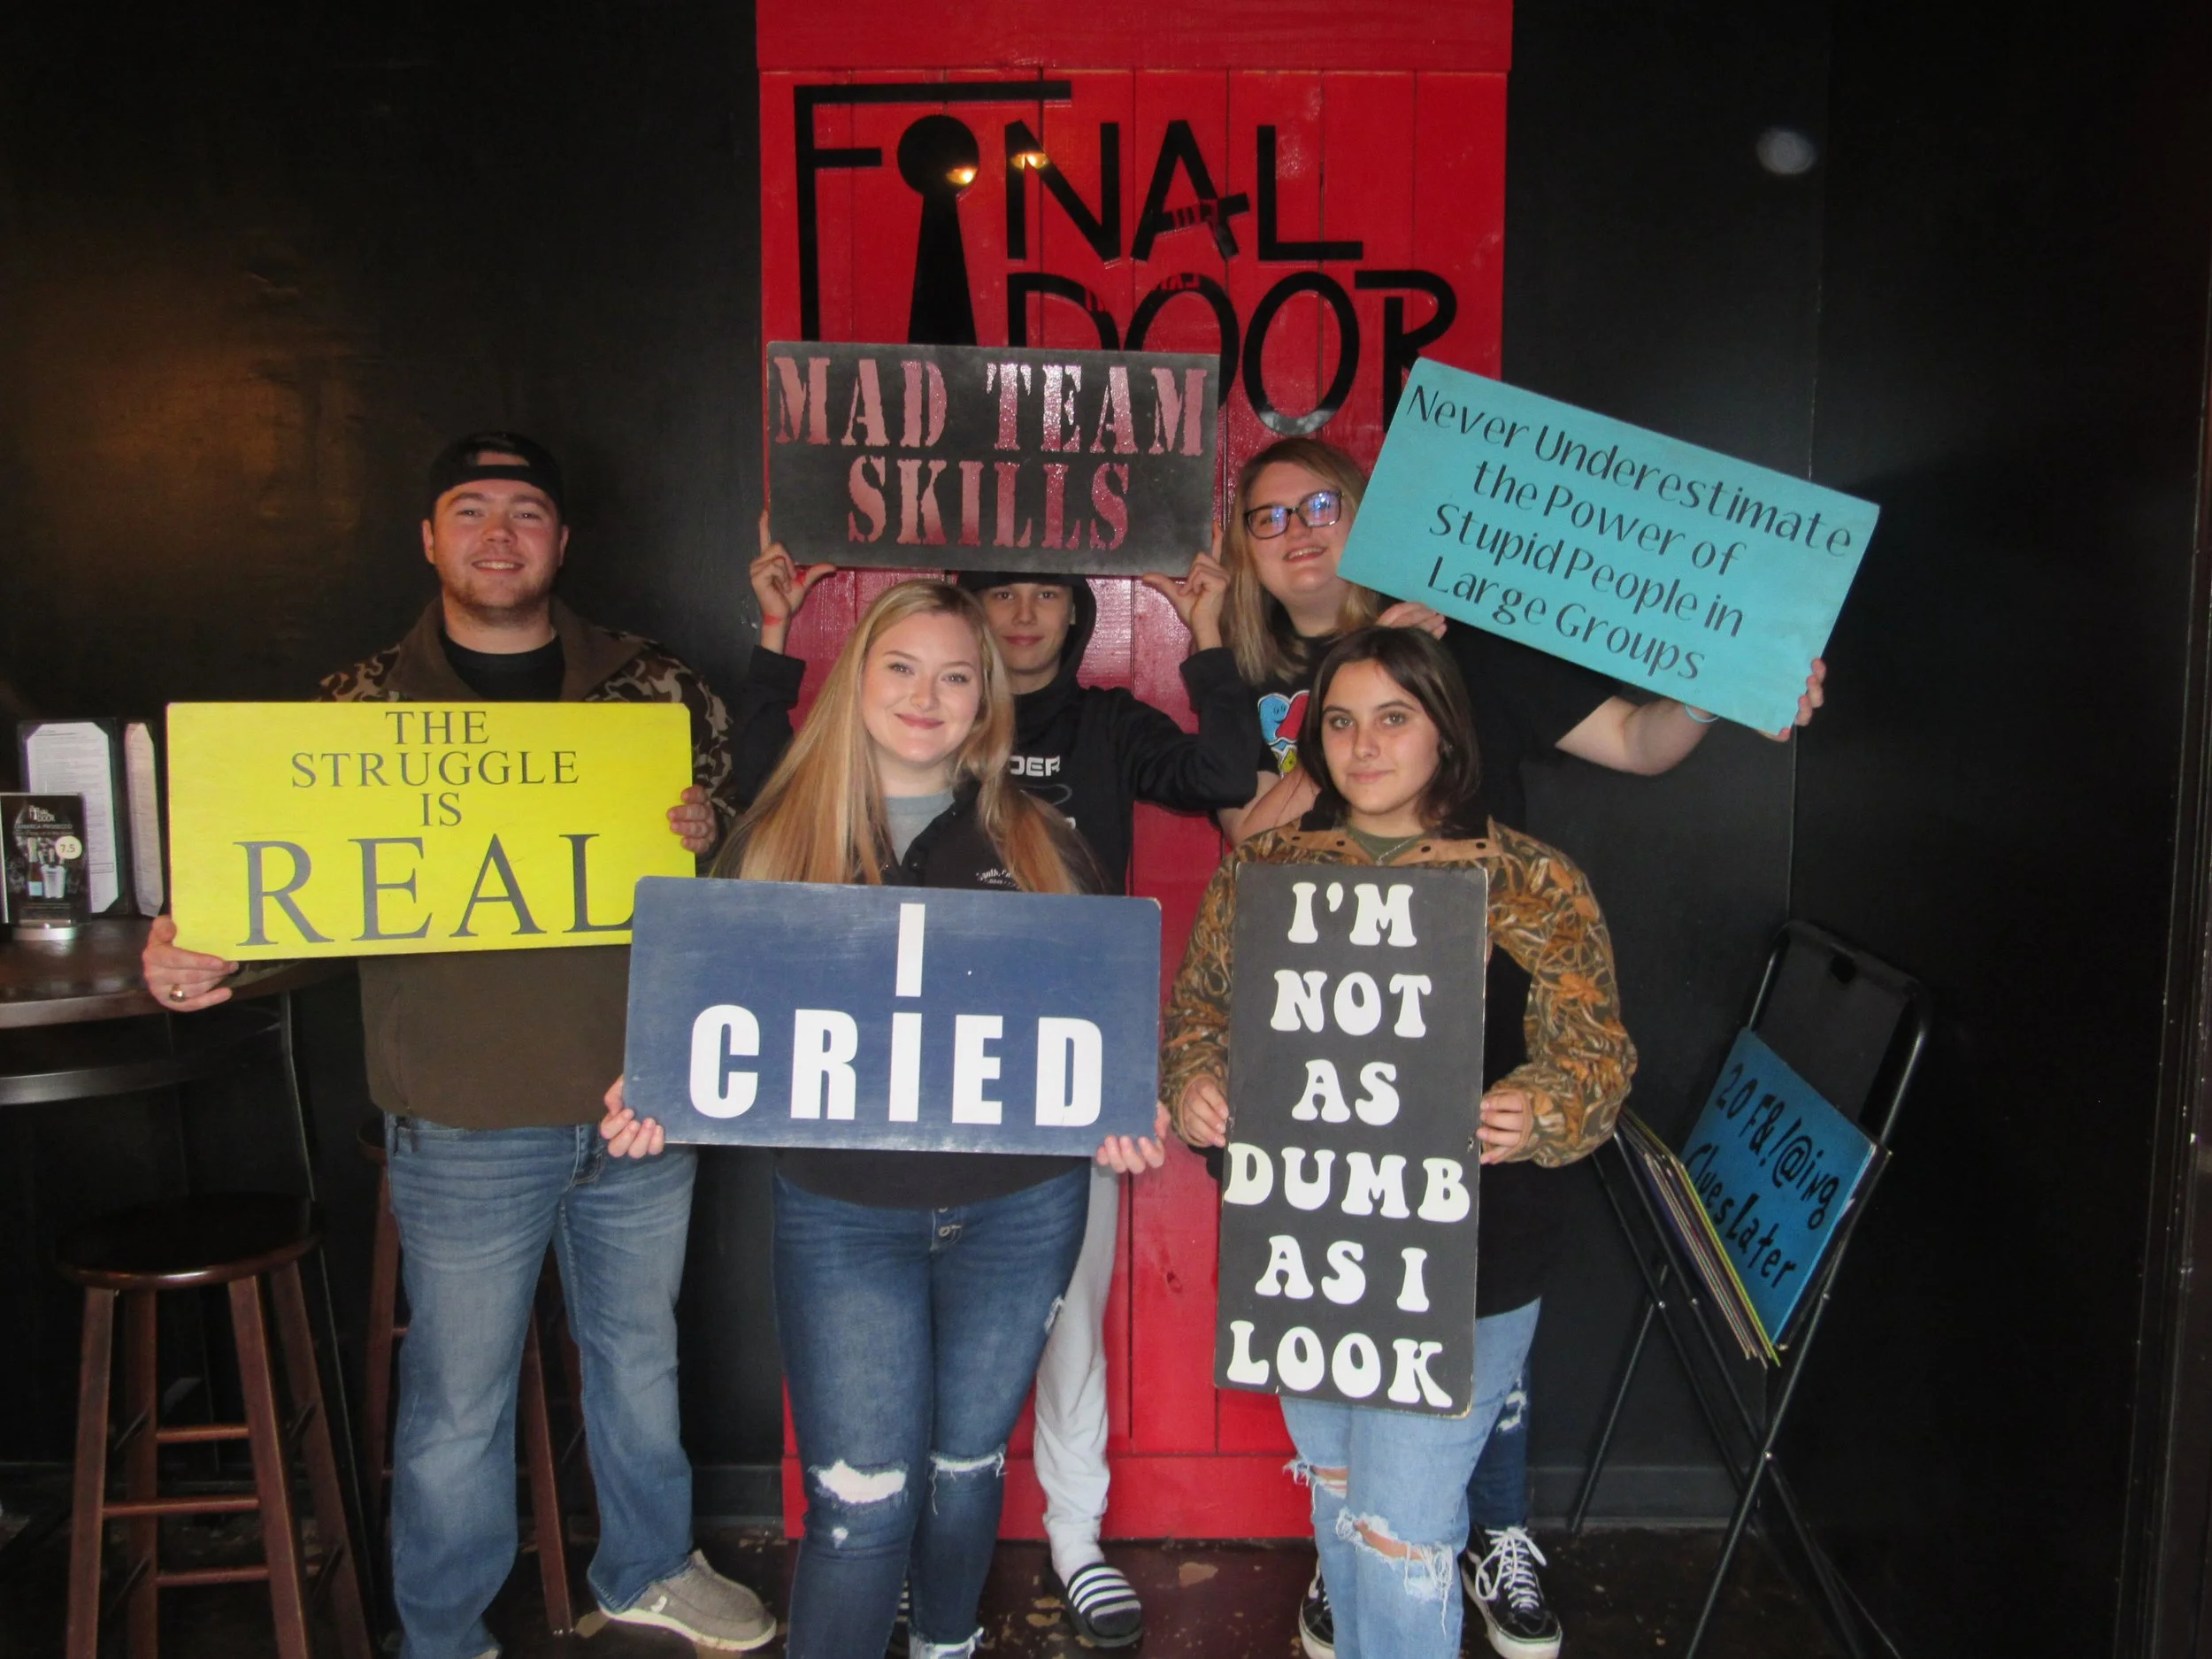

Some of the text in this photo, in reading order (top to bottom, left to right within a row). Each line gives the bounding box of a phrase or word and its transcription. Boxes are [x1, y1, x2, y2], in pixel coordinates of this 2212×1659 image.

[772, 356, 1209, 457] MAD TEAM
[848, 455, 1131, 549] SKILLS
[1407, 385, 1852, 557] Never Underestimate
[1473, 460, 1747, 577] the Power of
[1429, 503, 1743, 638] Stupid People in
[1428, 557, 1706, 680] Large Groups
[291, 750, 580, 788] STRUGGLE
[385, 710, 490, 745] THE
[420, 792, 463, 827] IS
[233, 833, 634, 948] REAL
[1288, 881, 1417, 947] I'M
[895, 902, 926, 997] I
[1271, 969, 1432, 1038] NOT
[689, 1004, 1102, 1127] CRIED
[1292, 1059, 1399, 1125] AS
[1715, 1063, 1758, 1118] 20
[1224, 1142, 1471, 1223] DUMB
[1256, 1234, 1430, 1312] AS I
[1728, 1193, 1797, 1289] Later
[1226, 1320, 1453, 1409] LOOK
